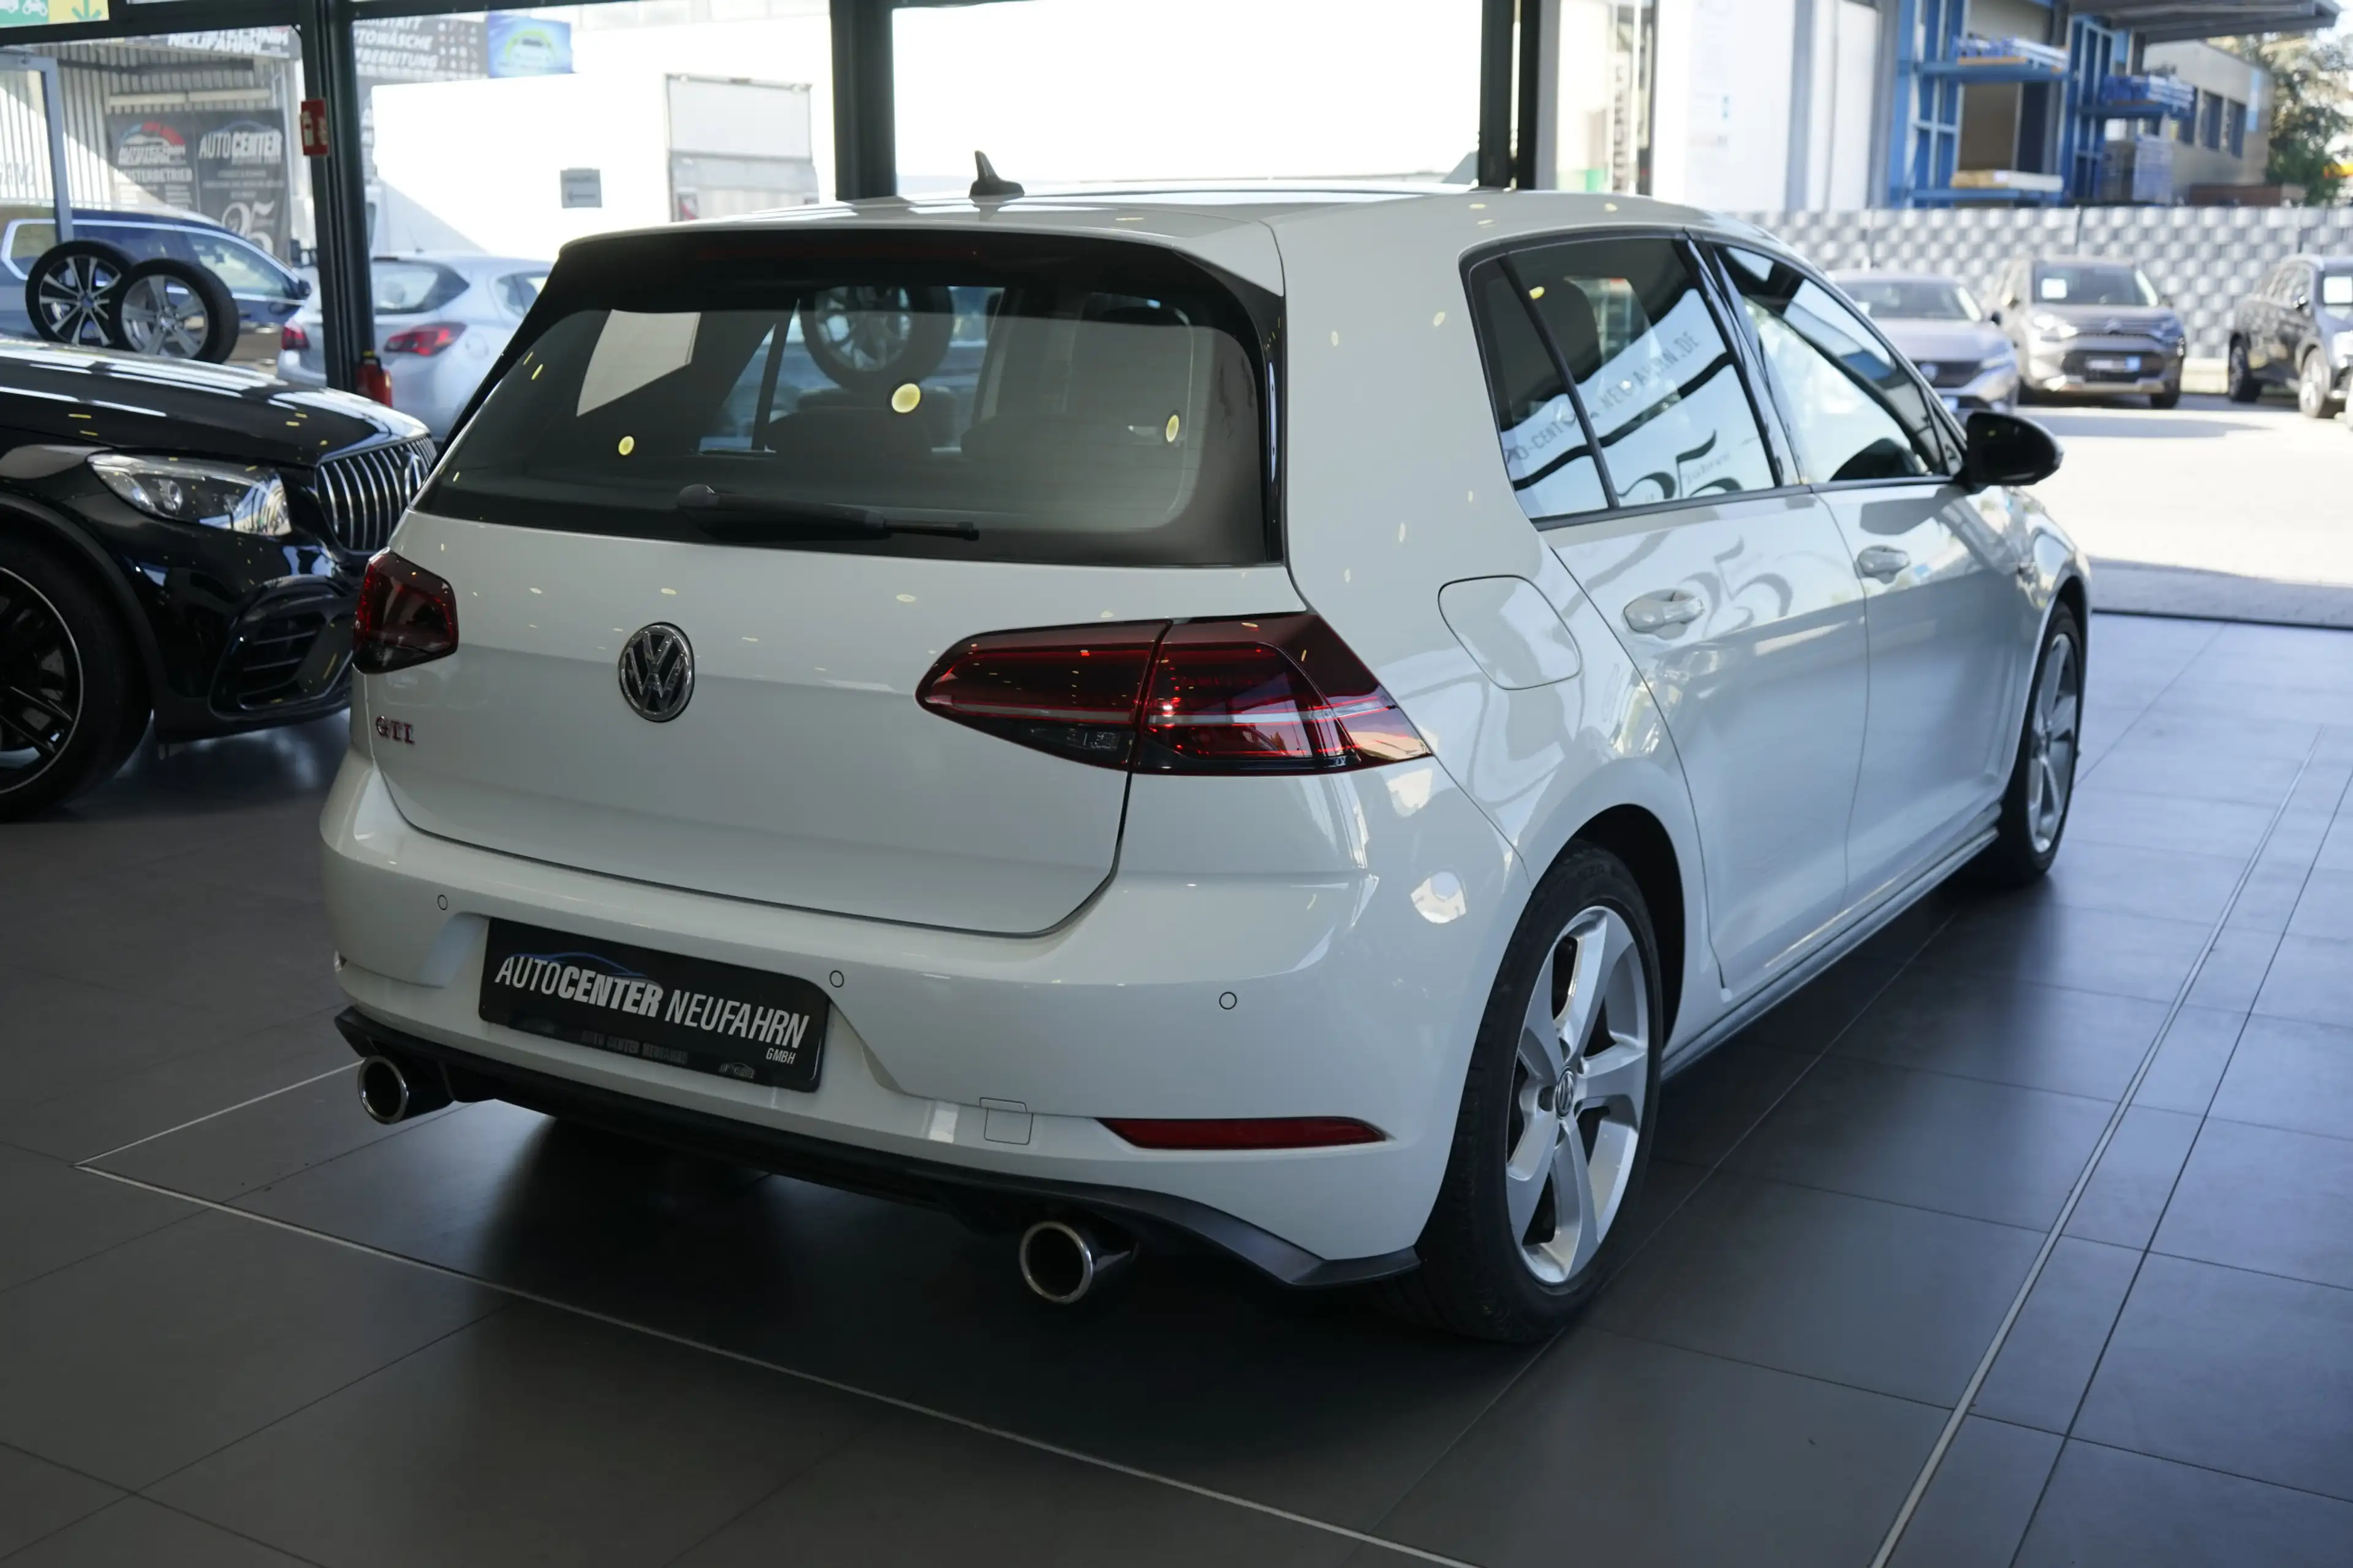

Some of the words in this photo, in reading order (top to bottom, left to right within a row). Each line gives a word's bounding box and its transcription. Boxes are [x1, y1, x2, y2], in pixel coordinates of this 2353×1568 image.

[199, 129, 282, 159] AUTOCENTER
[620, 623, 692, 721] VW
[376, 716, 415, 746] GTI
[495, 956, 663, 1018] AUTOCENTER
[665, 990, 809, 1048] NEUFAHRN
[766, 1047, 797, 1065] GMBH
